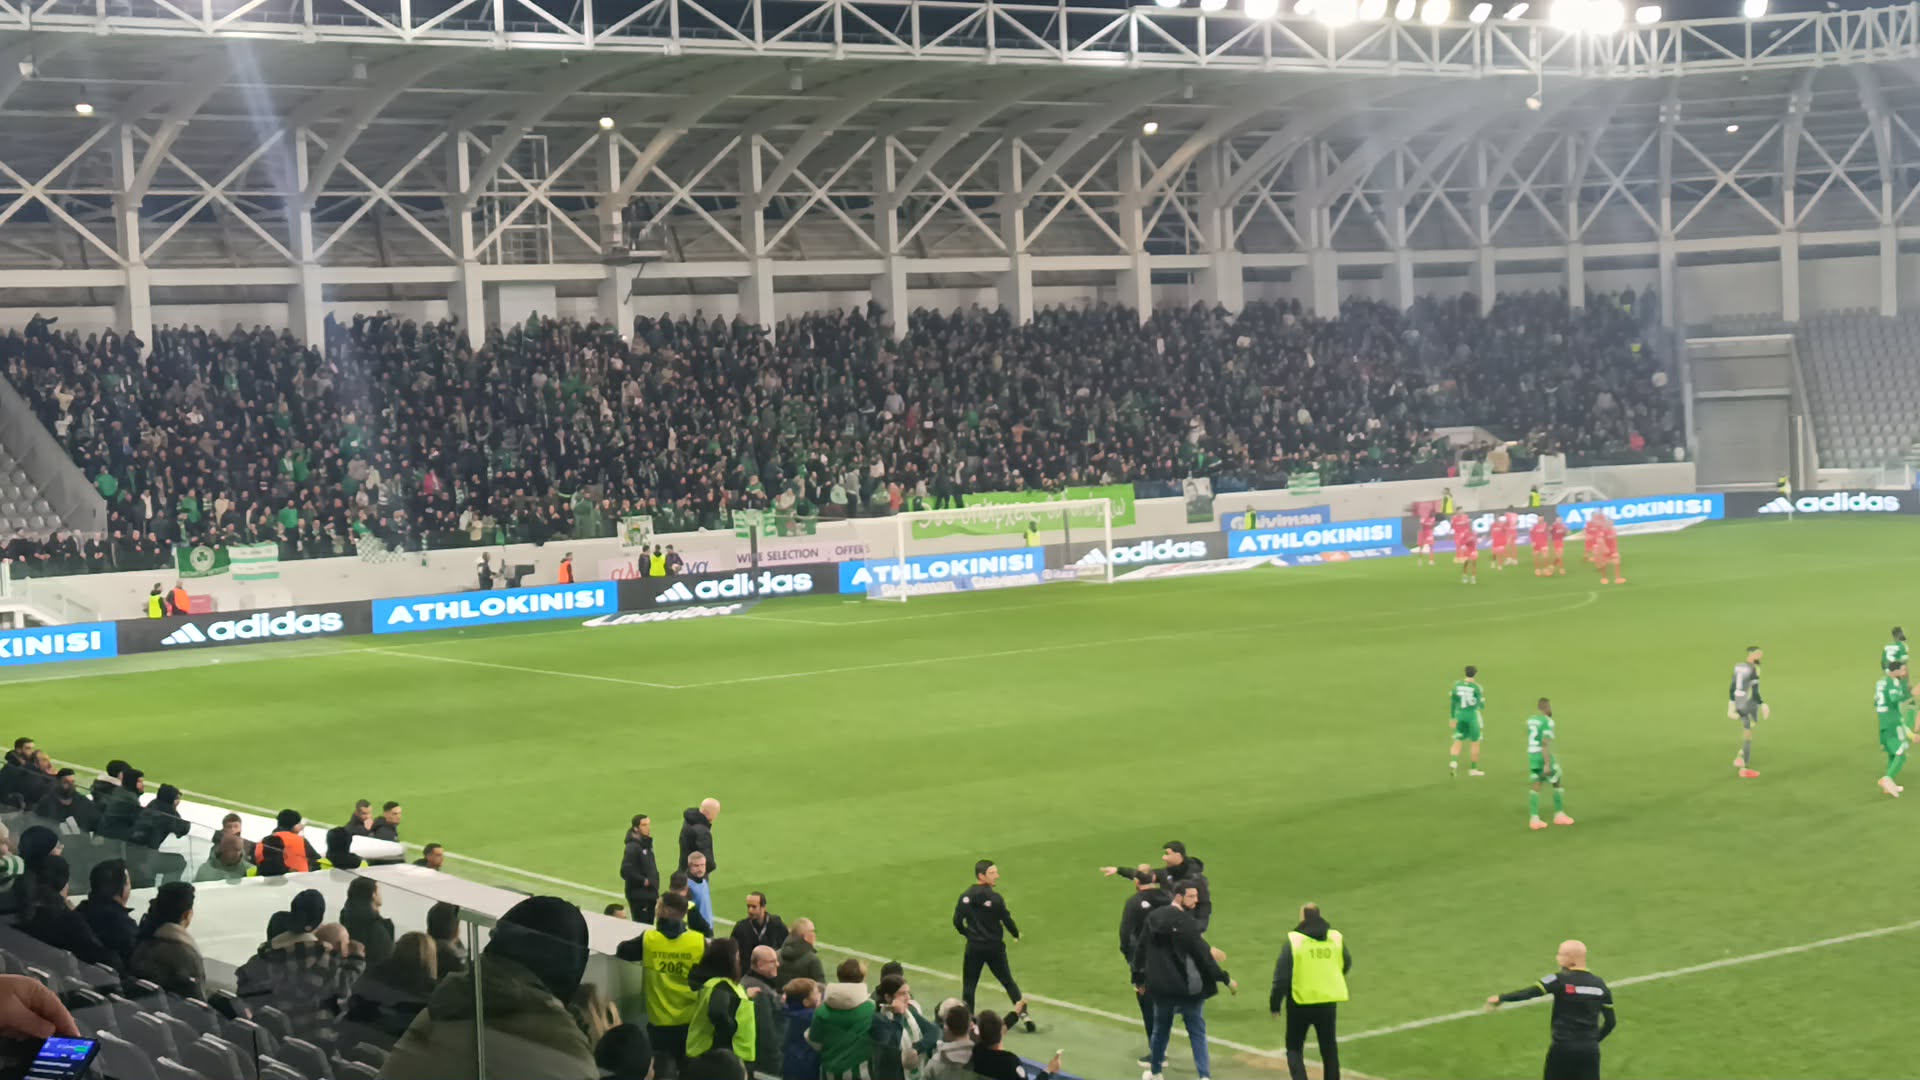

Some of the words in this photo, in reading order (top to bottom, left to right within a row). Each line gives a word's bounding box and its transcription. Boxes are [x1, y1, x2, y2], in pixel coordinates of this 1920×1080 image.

[1796, 492, 1900, 512] adidas
[1238, 524, 1392, 553] ATHLOKINISI
[767, 548, 819, 561] SELECTION
[835, 544, 870, 556] OFFERS
[1110, 538, 1207, 564] adidas
[851, 553, 1034, 586] ATHLOKINISI
[387, 588, 604, 625] ATHLOKINISI
[207, 610, 343, 641] adidas
[1529, 725, 1540, 745] 2
[1309, 947, 1332, 959] 180
[659, 961, 684, 973] 208
